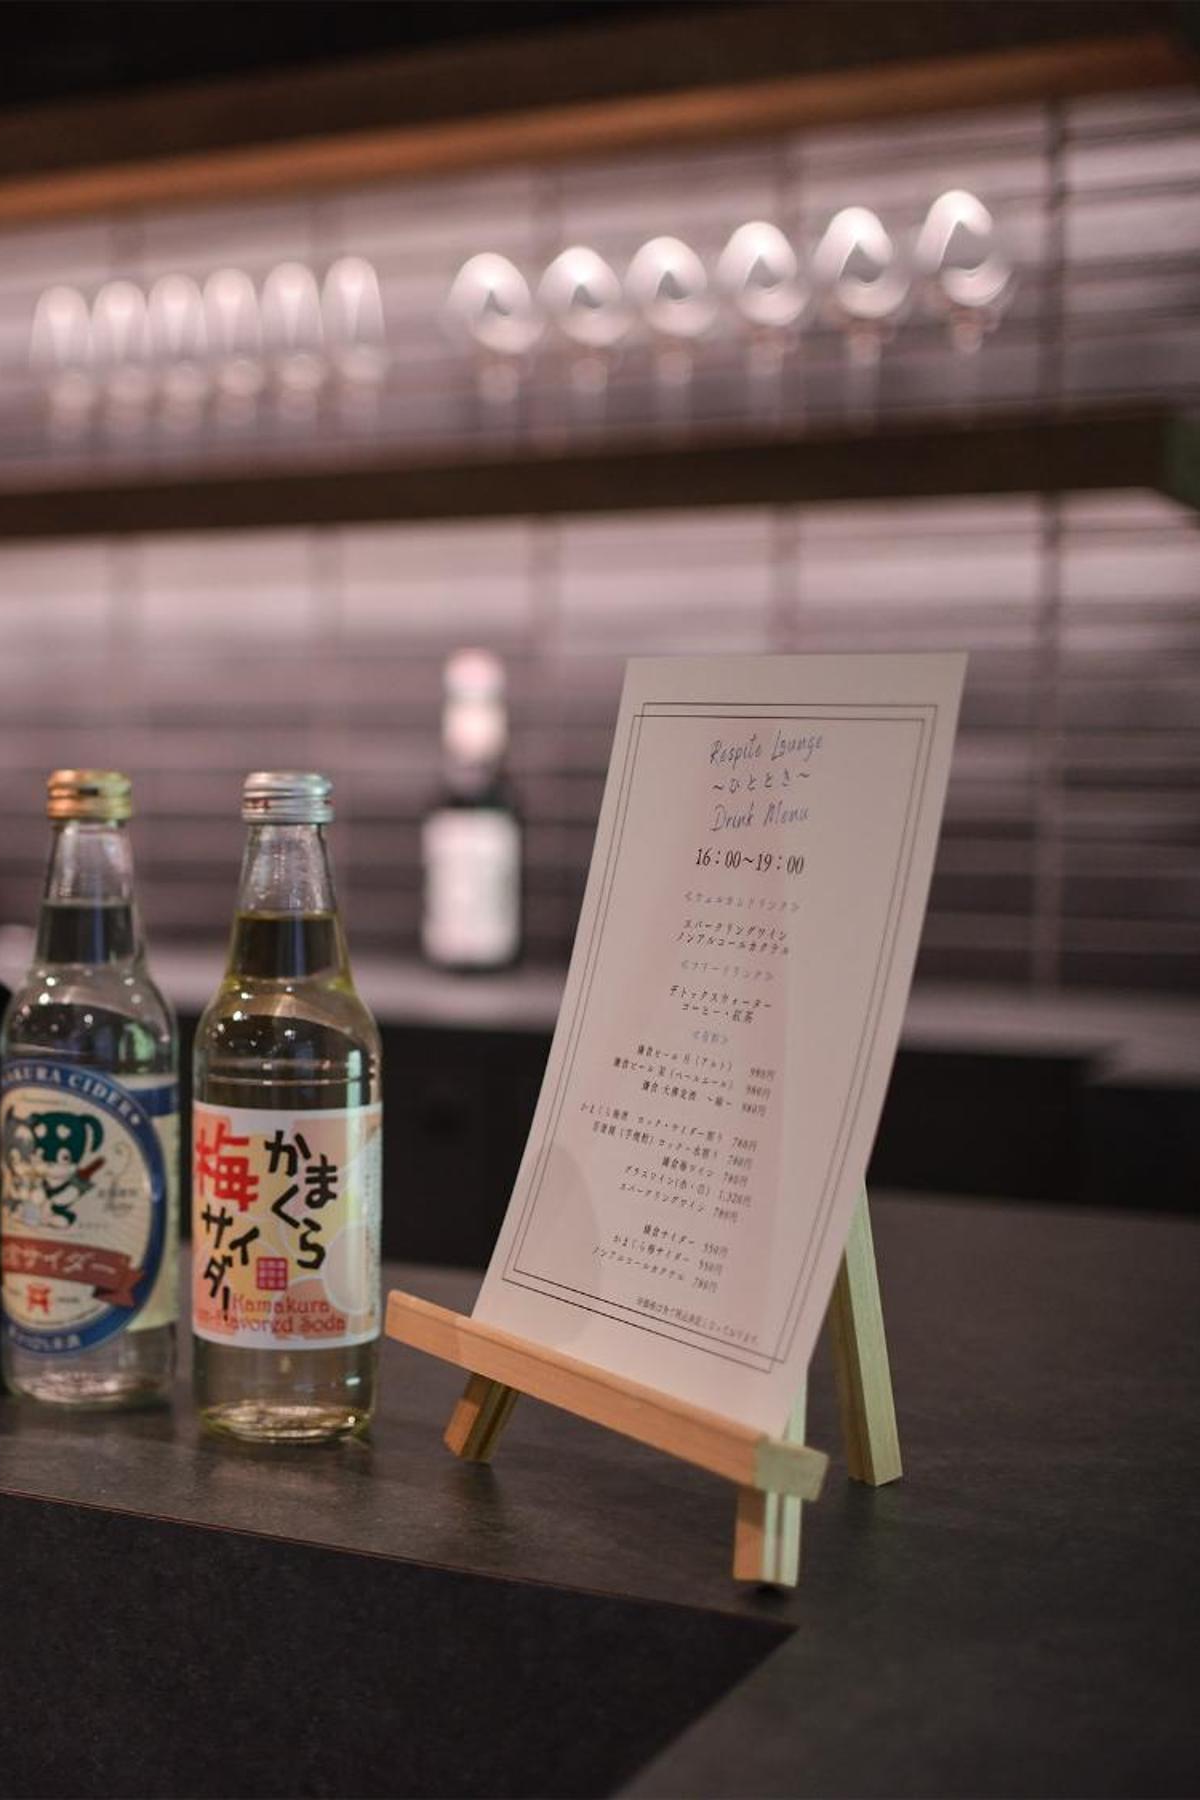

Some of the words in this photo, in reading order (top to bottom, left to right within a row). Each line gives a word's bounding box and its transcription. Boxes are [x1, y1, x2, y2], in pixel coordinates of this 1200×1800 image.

[710, 800, 755, 832] Drink
[264, 1129, 338, 1270] かまくら
[231, 1293, 330, 1314] Kamakura
